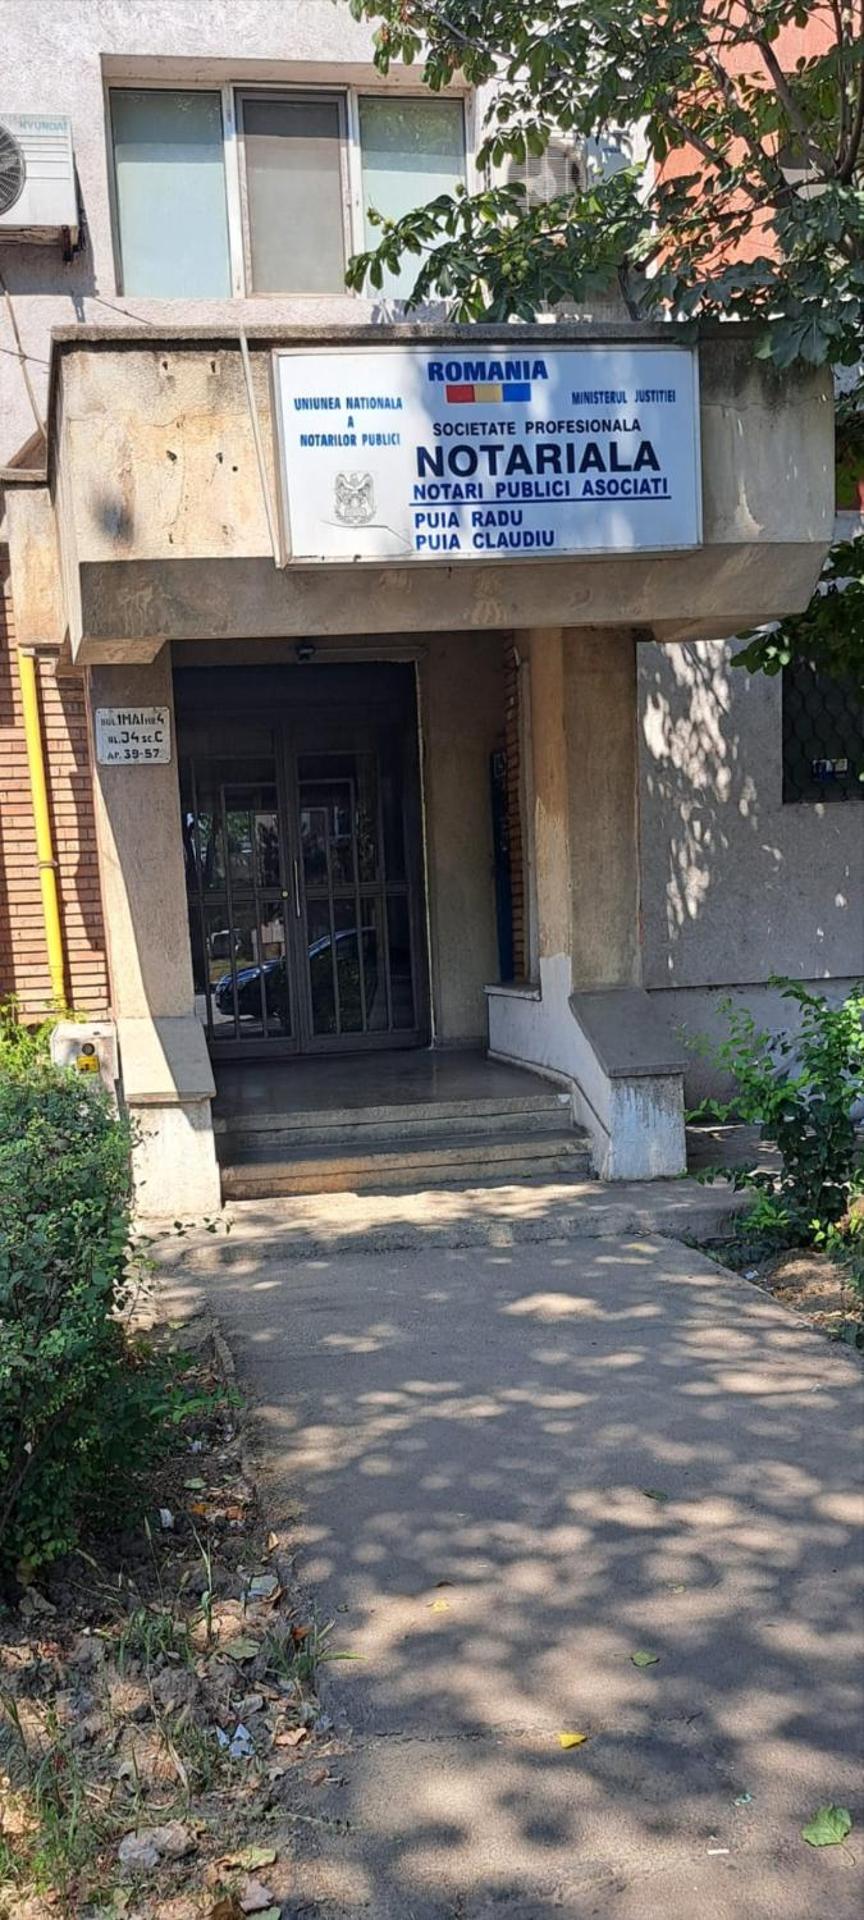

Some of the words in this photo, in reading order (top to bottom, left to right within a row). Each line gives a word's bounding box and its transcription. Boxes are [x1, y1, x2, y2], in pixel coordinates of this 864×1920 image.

[428, 360, 549, 381] ROMANIA
[294, 397, 341, 410] UNIUNEA
[346, 397, 403, 410] NATIONALA
[571, 390, 627, 405] MINISTERUL
[635, 389, 676, 403] JUSTITIEI
[347, 415, 355, 428] A
[433, 421, 516, 436] SOCIETATE
[525, 418, 641, 435] PROFESIONALA
[300, 434, 356, 447] NOTARILOR
[362, 433, 400, 446] PUBLICI
[416, 440, 661, 478] NOTARIALA
[413, 482, 483, 500] NOTARI
[495, 480, 570, 498] PUBLICI
[582, 477, 668, 496] ASOCIATI
[415, 511, 460, 528] PUIA
[471, 509, 523, 527] RADU
[416, 533, 461, 550] PUIA
[472, 530, 554, 548] CLAUDIU
[156, 713, 164, 725] 4
[154, 731, 163, 743] C
